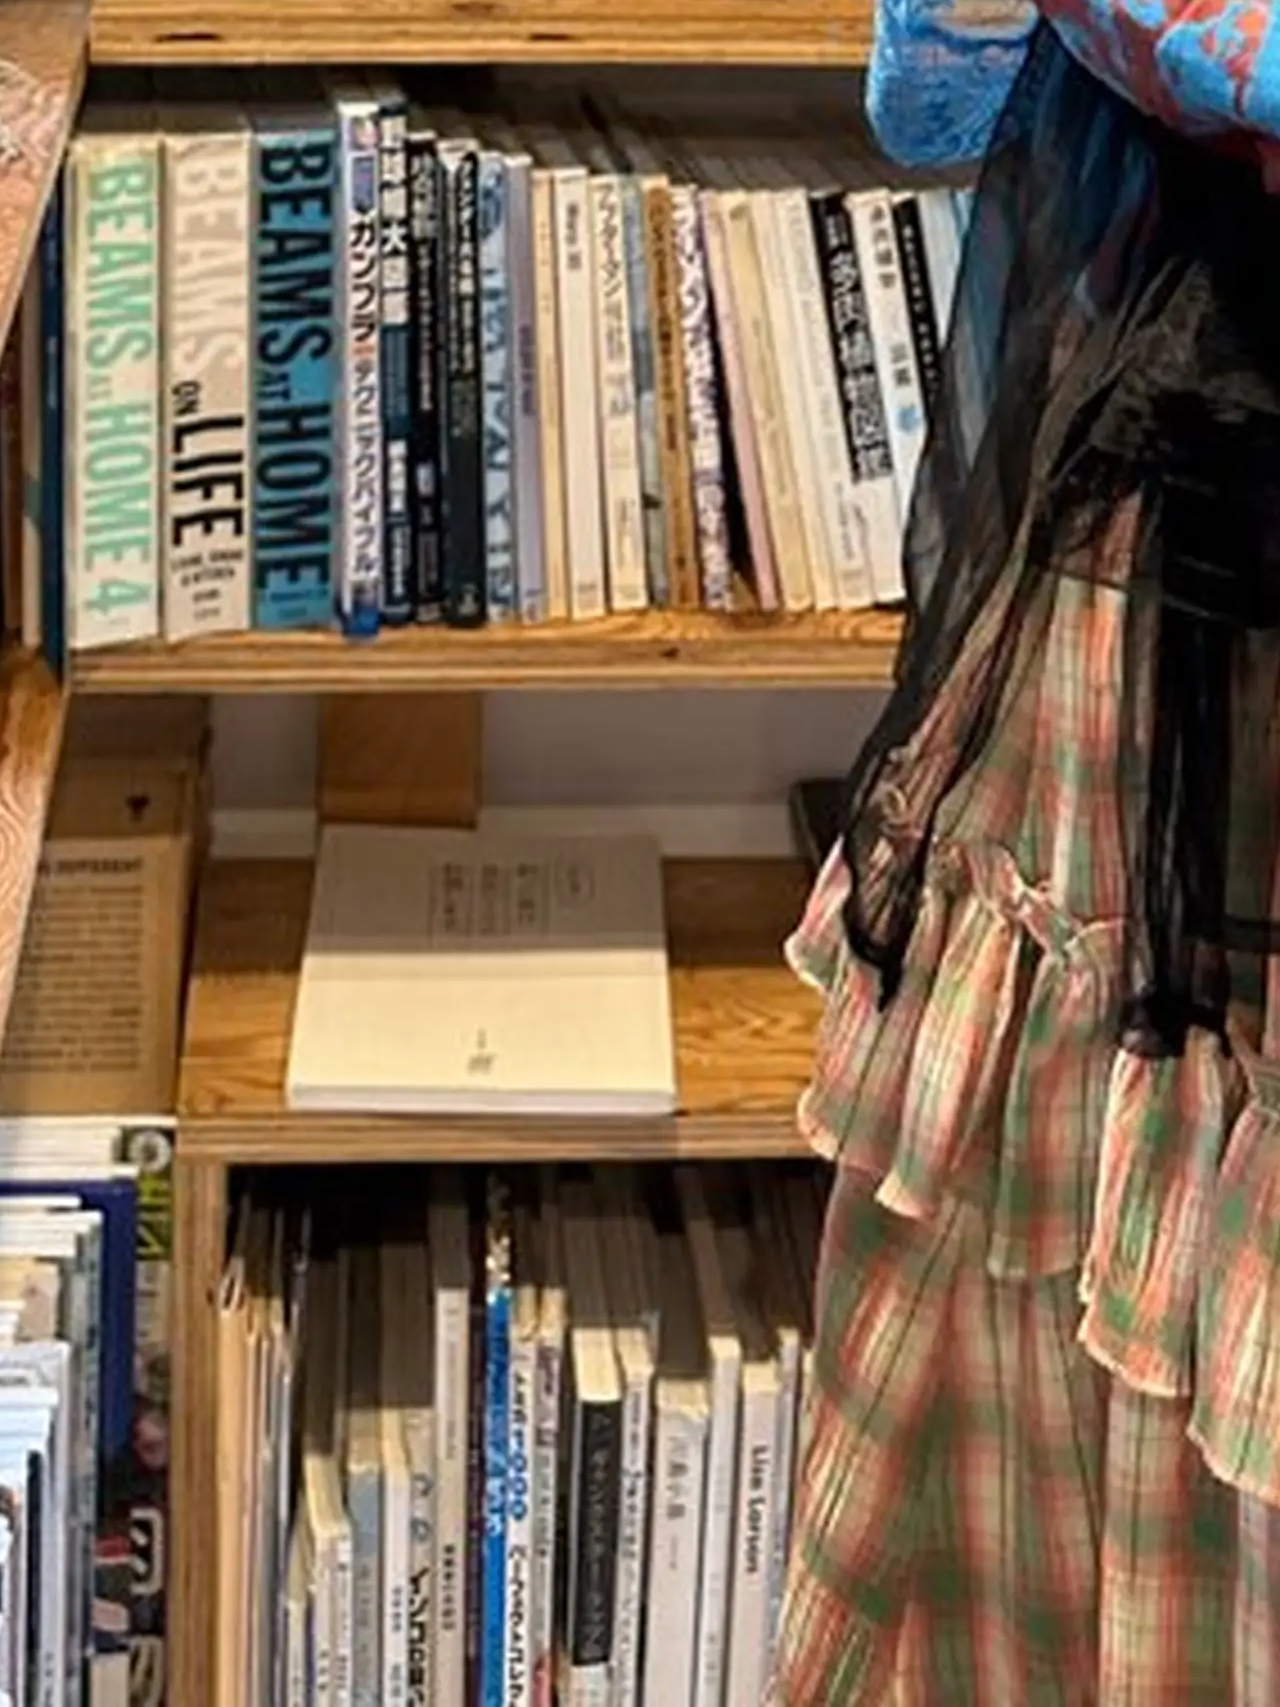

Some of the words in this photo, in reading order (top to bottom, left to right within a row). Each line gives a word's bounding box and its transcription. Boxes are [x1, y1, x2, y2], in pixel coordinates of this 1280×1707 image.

[85, 161, 154, 368] BEAMS
[172, 153, 243, 372] BEAMS
[258, 142, 333, 365] BEAMS
[171, 380, 202, 416] ON
[258, 369, 291, 402] AT
[85, 403, 152, 571] HOME
[171, 416, 244, 547] LIFE
[257, 402, 332, 590] HOME
[85, 578, 150, 615] 4
